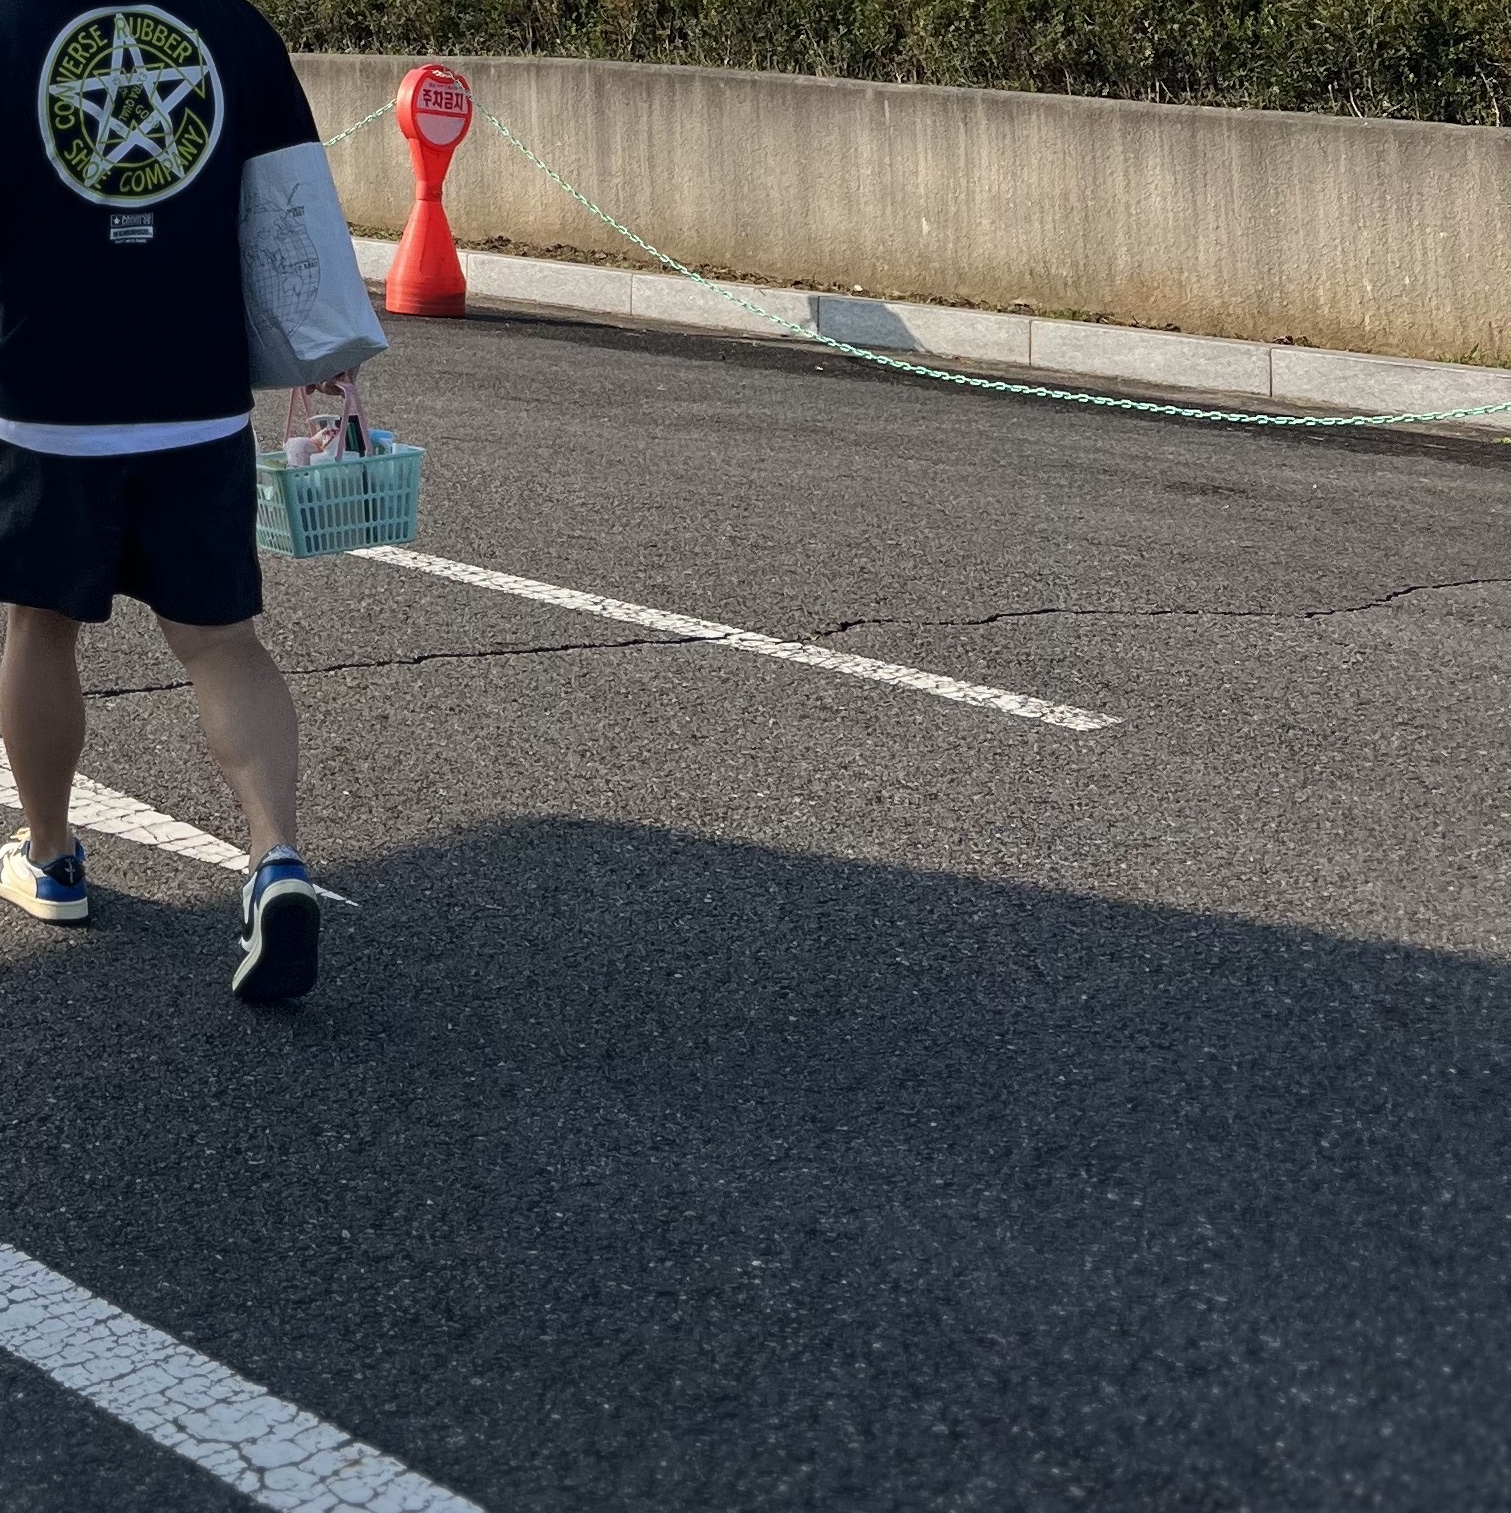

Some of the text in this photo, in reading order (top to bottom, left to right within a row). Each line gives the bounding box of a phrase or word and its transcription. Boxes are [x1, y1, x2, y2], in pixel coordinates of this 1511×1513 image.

[54, 17, 193, 129] CONVERSE RUBBER
[422, 88, 464, 111] 주차금지
[64, 125, 204, 192] SHOE COMPANY
